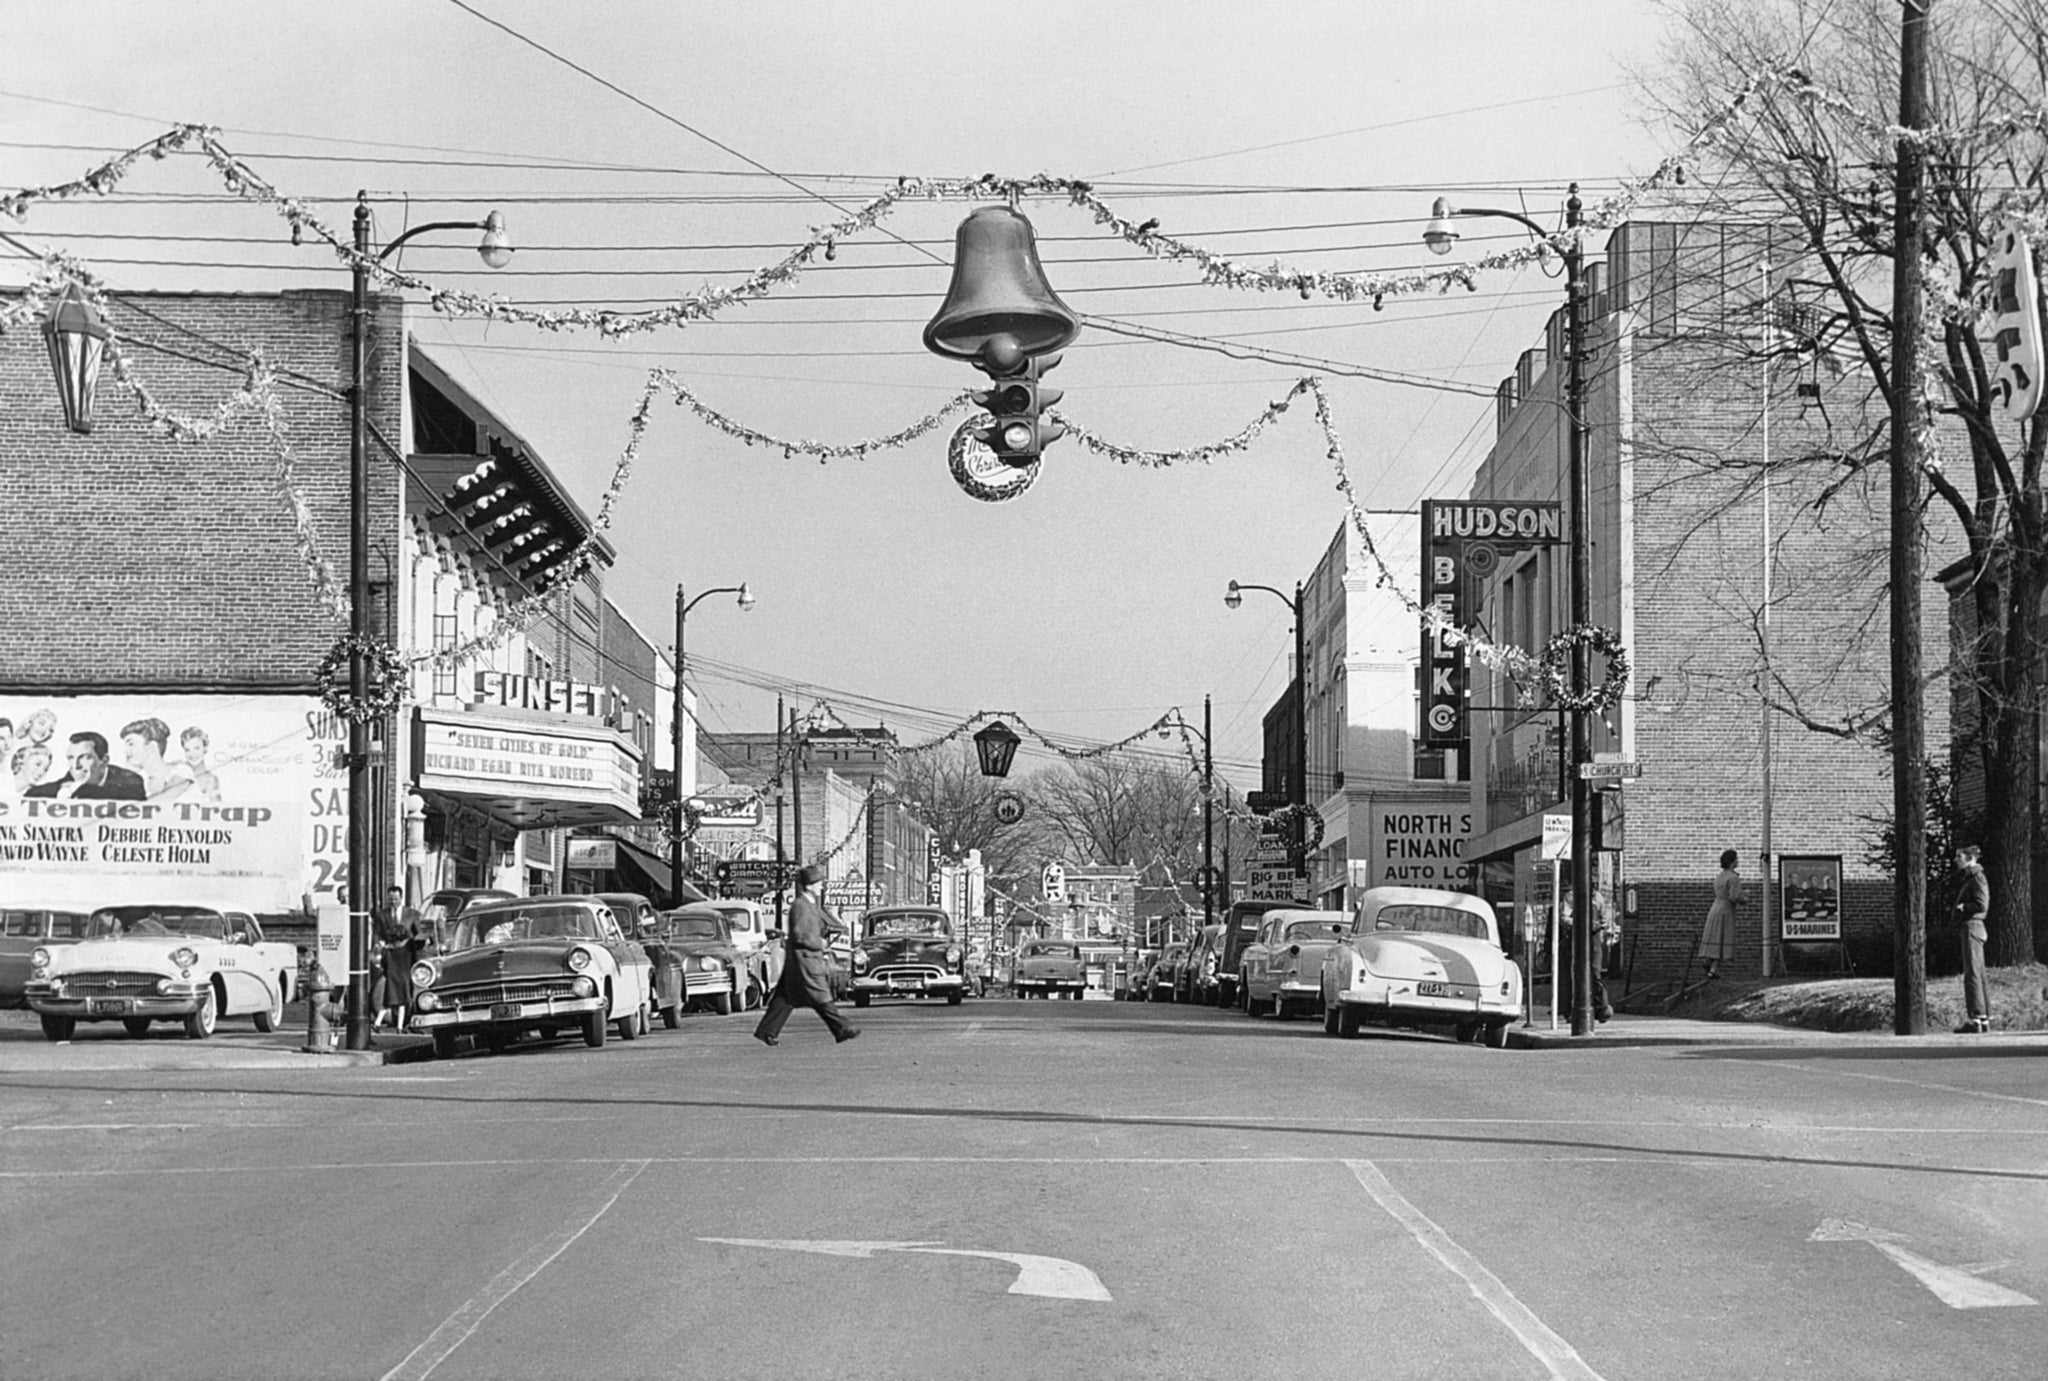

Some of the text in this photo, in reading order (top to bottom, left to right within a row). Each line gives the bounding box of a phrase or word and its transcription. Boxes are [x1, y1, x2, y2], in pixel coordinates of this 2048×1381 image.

[1433, 507, 1560, 538] HUDSON
[475, 672, 606, 718] SUNSET
[500, 738, 535, 752] CITIES
[539, 742, 553, 756] OF
[426, 753, 476, 772] RICHARD
[481, 758, 512, 775] EGAN
[520, 762, 544, 777] RITA
[1591, 765, 1621, 777] CHURCH
[21, 800, 161, 819] Tender
[173, 803, 272, 827] Trap
[23, 824, 84, 842] SINATRA
[98, 825, 152, 843] DEBBIE
[157, 826, 232, 844] REYNOLDS
[1383, 814, 1452, 834] NORTH
[37, 843, 89, 861] WAYNE
[102, 844, 164, 863] CELESTE
[168, 845, 210, 863] HOLM
[1386, 838, 1465, 859] FINANC
[1251, 872, 1311, 887] BIG BER
[1385, 866, 1434, 879] AUTO
[849, 894, 878, 905] LOAS
[1251, 890, 1313, 901] MARKT
[1799, 924, 1837, 935] MARINES
